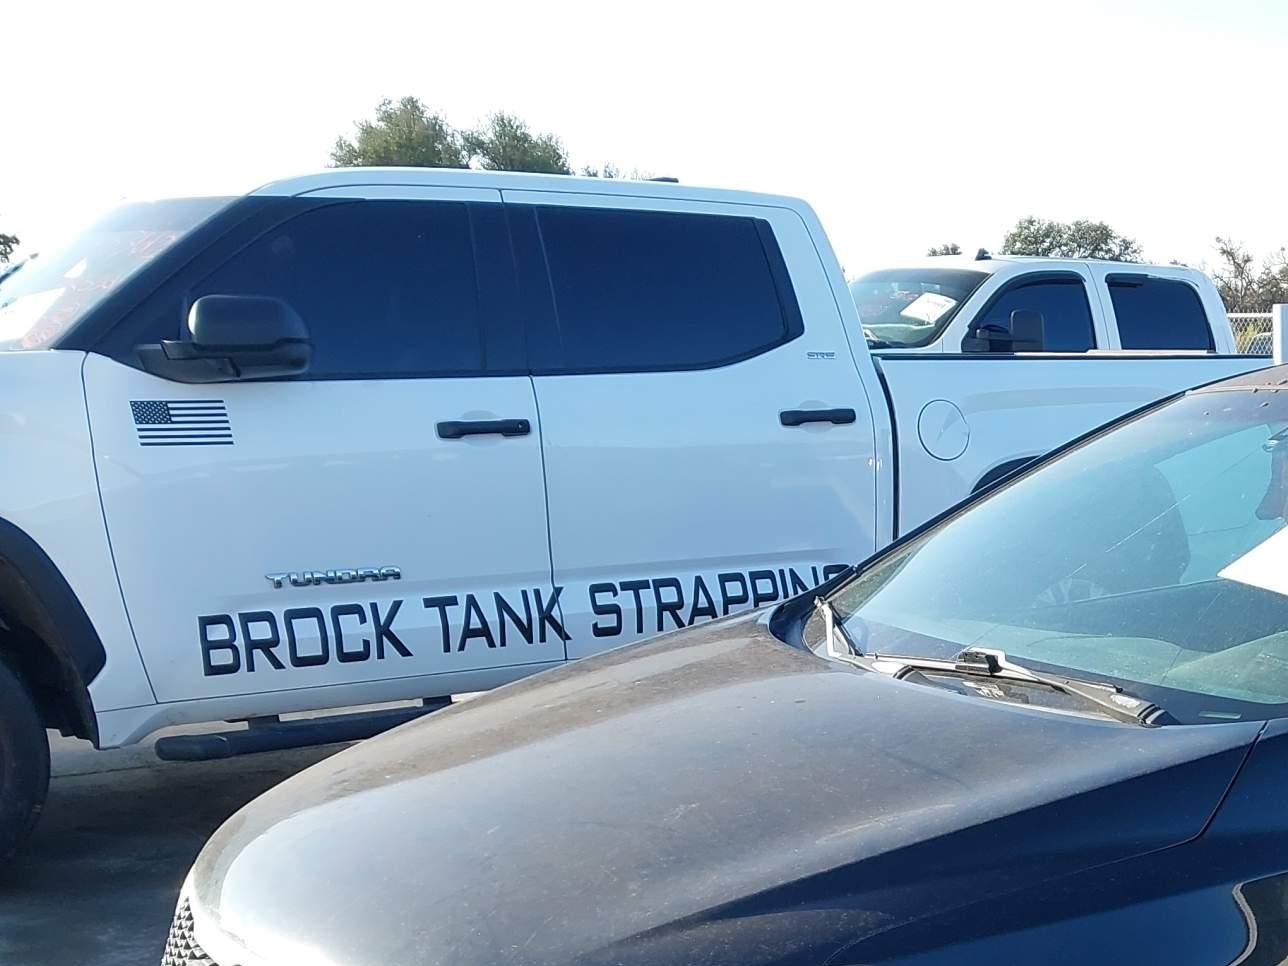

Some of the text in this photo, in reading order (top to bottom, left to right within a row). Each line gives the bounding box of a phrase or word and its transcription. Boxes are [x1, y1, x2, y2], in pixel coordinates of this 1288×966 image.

[265, 565, 402, 589] TUNDRA
[197, 599, 414, 677] BROCK
[422, 585, 573, 654] TANK
